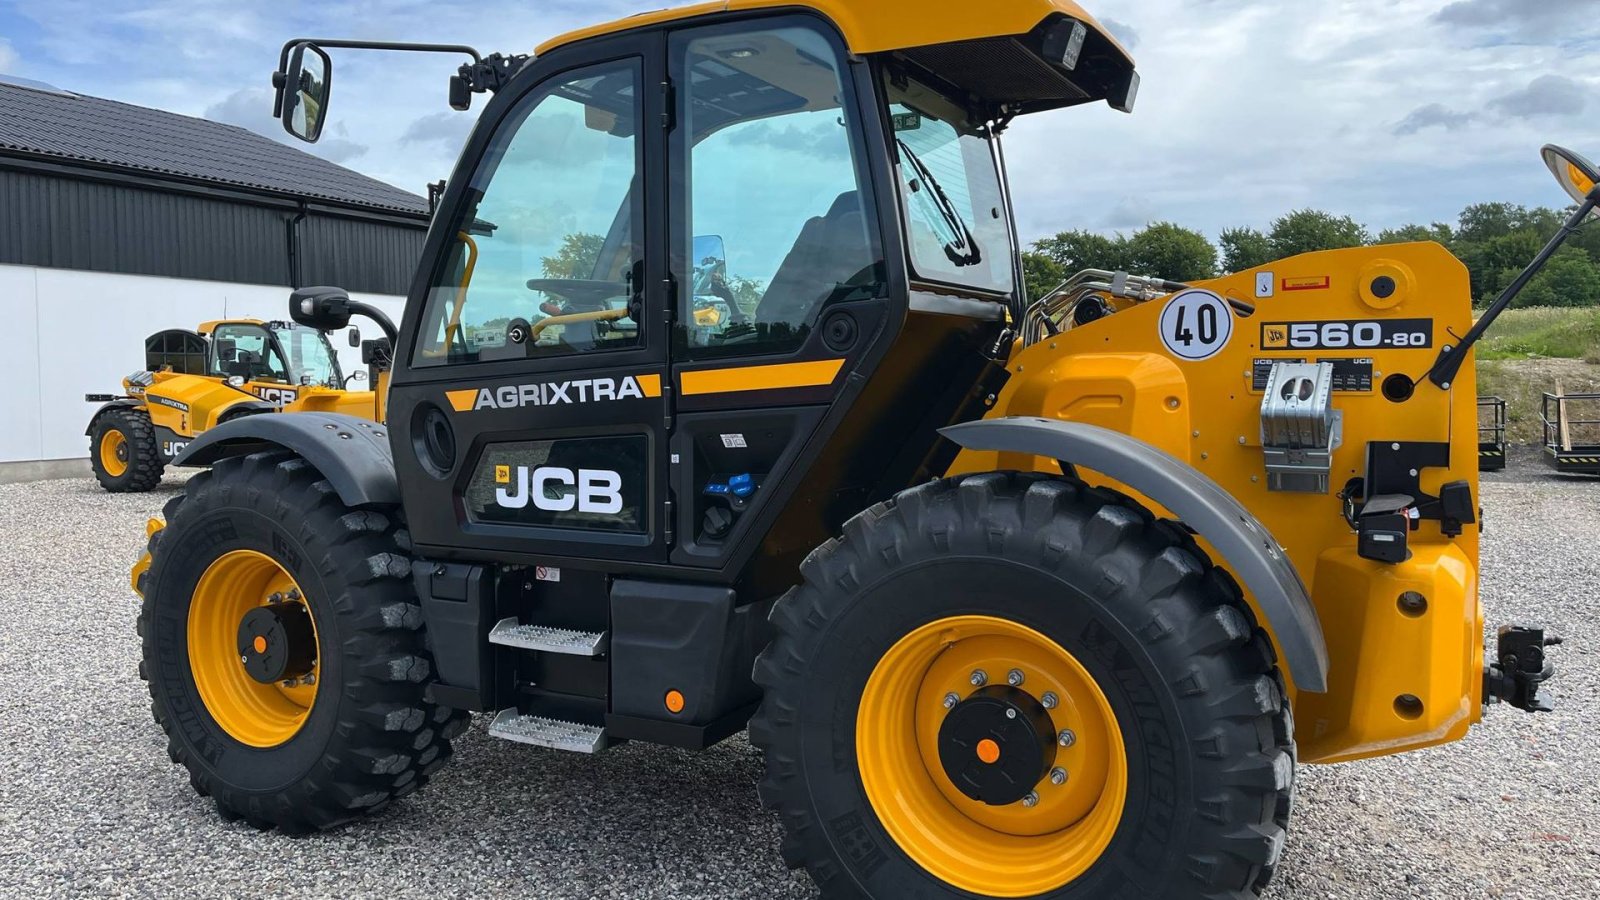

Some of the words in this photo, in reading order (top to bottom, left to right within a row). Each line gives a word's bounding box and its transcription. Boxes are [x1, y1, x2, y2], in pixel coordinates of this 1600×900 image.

[1174, 303, 1217, 346] 40
[1290, 322, 1426, 348] 560-80
[475, 376, 643, 410] AGRIXTRA
[164, 441, 190, 456] JC
[496, 466, 623, 514] JCB
